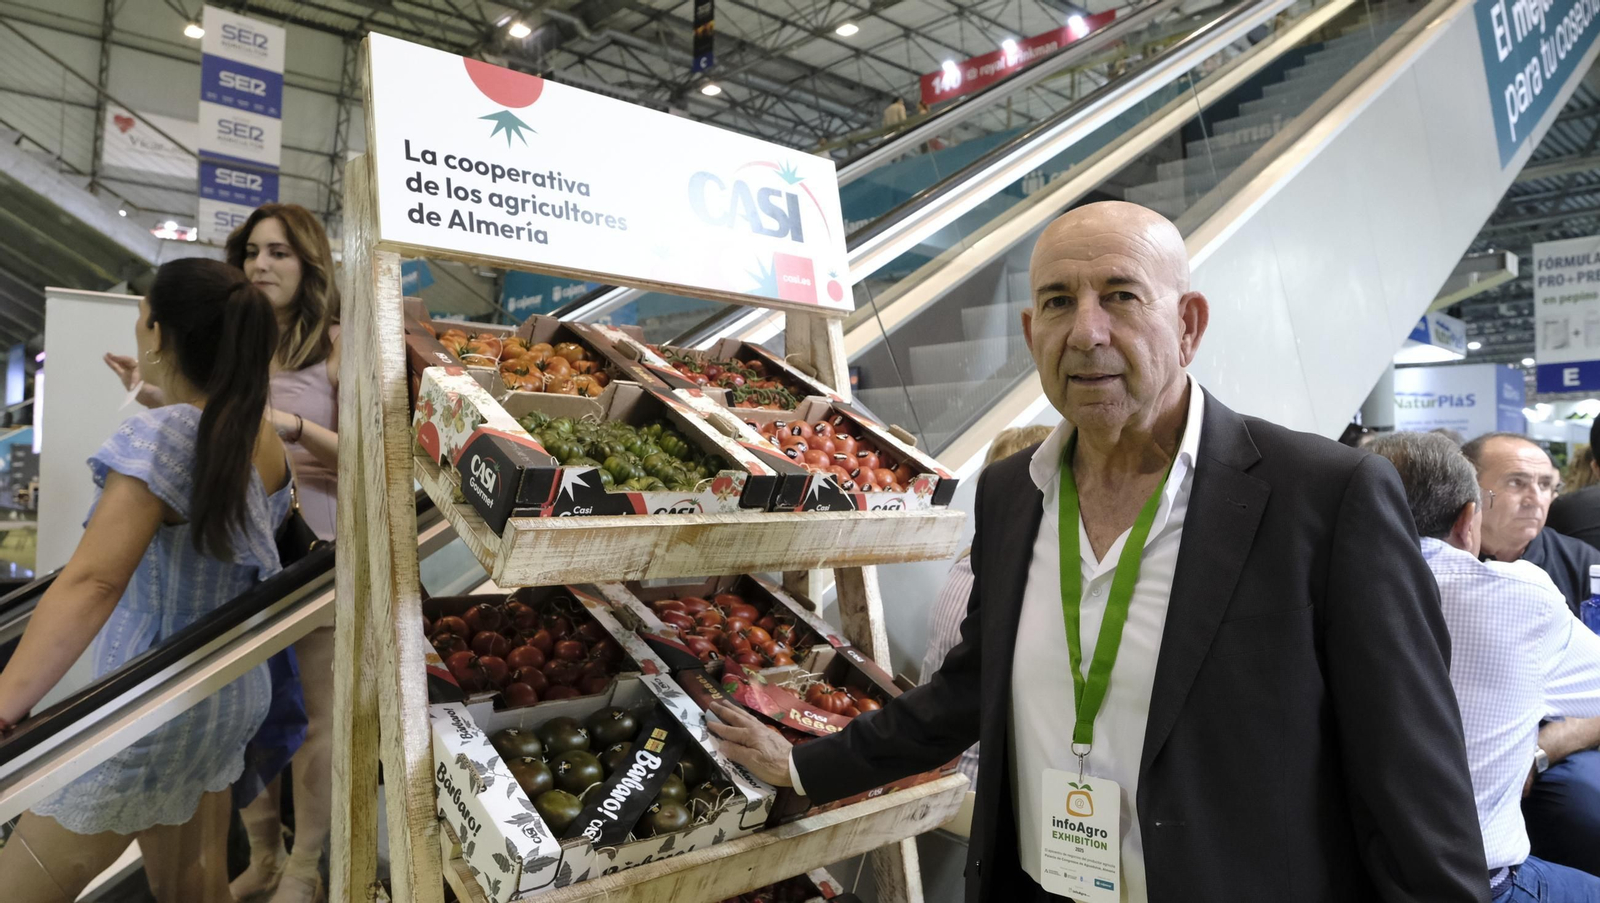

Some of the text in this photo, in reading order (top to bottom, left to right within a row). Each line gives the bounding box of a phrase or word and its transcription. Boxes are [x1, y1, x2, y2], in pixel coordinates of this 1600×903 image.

[222, 24, 268, 50] SER
[1490, 0, 1513, 62] El
[979, 55, 1006, 77] royal
[218, 70, 267, 97] SER
[1504, 56, 1543, 142] para
[1540, 35, 1558, 80] tu
[218, 118, 264, 142] SER
[214, 168, 263, 192] SER
[404, 139, 591, 197] La cooperativa
[405, 171, 628, 231] de los agricultores
[688, 171, 804, 243] CASI
[214, 211, 246, 228] SE
[407, 202, 549, 245] de Almería
[782, 273, 811, 287] casi.es
[1538, 274, 1564, 288] PRO
[1563, 368, 1580, 386] E
[471, 454, 496, 494] CASI
[470, 476, 494, 508] Gourmet
[573, 506, 593, 514] Casi
[804, 710, 828, 722] CASI
[868, 787, 884, 798] CASI
[525, 826, 542, 844] CASI
[1052, 816, 1108, 838] infoAgro
[1052, 830, 1108, 850] EXHIBITION
